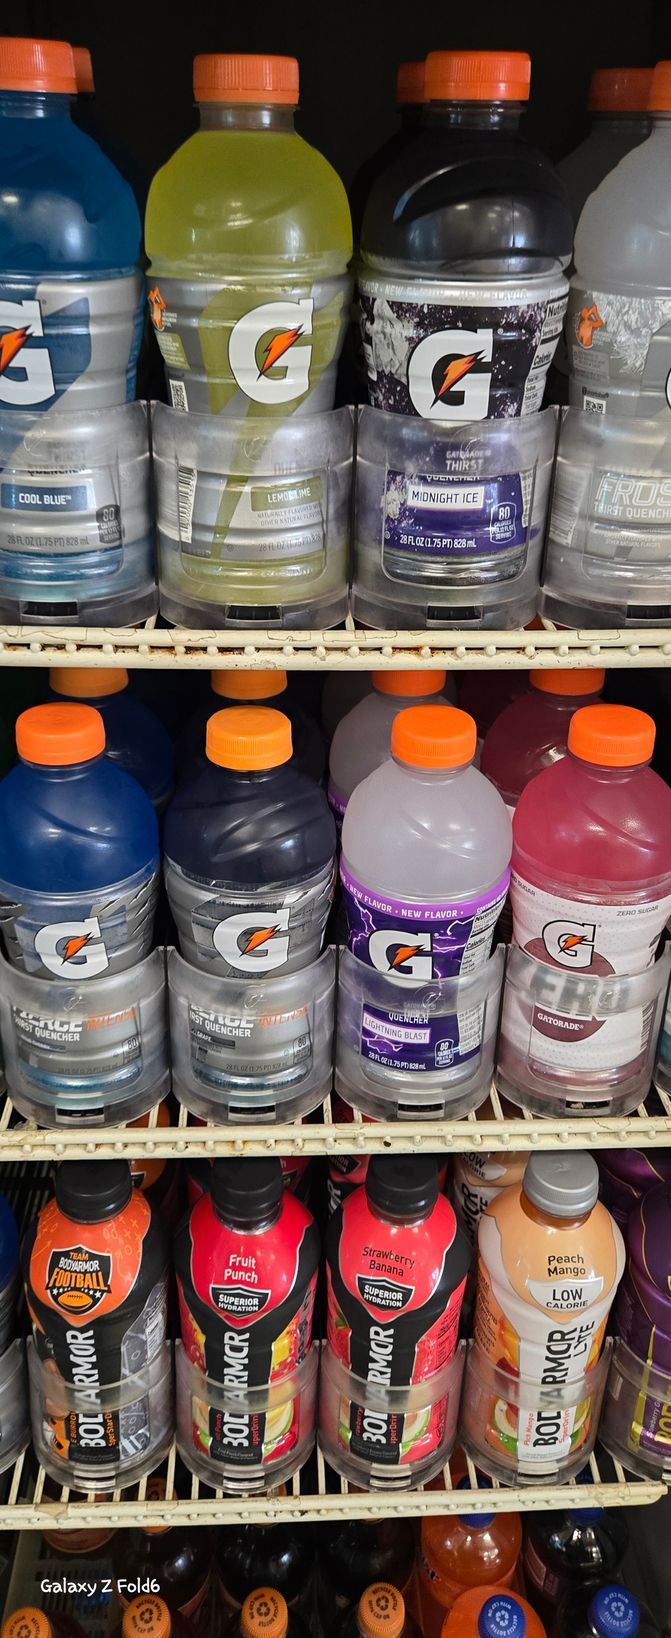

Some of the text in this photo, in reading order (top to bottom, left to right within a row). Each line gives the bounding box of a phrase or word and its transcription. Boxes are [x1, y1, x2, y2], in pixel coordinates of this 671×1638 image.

[446, 460, 484, 472] THIRST
[18, 493, 42, 505] COOL
[412, 491, 479, 504] MIDNIGHT ICE
[103, 507, 115, 522] 80
[498, 506, 511, 521] 80
[594, 502, 623, 516] TIRST
[25, 536, 35, 547] OZ
[400, 534, 477, 549] 28 FL OZ (1.75 PT) 828 mL
[350, 886, 458, 919] NEW FLAVOR NEW FLAVOR
[638, 904, 659, 915] SUGAR
[35, 1028, 81, 1042] QUENCHER
[204, 1021, 251, 1038] QUENCHER
[364, 1017, 427, 1041] LIGHTNING BLAST
[128, 1037, 138, 1050] 80
[298, 1037, 307, 1048] 80
[440, 1042, 449, 1051] 80
[375, 1054, 381, 1062] FL
[381, 1057, 388, 1065] OZ
[409, 1062, 419, 1070] 828
[70, 1252, 89, 1260] TEAM
[229, 1254, 256, 1269] Fruit
[362, 1246, 415, 1269] Strawberry
[548, 1254, 584, 1266] Peach
[58, 1257, 100, 1272] BODYARMOR
[369, 1260, 404, 1276] Banana
[548, 1266, 586, 1277] Mango
[49, 1267, 108, 1291] FOOTBALL
[224, 1268, 259, 1284] Punch
[218, 1294, 259, 1306] SUPERIOR
[363, 1293, 403, 1307] HYDRATION
[364, 1285, 403, 1301] SUPERIOR
[552, 1288, 583, 1302] LOW
[218, 1302, 259, 1312] HYDRATION
[546, 1300, 589, 1310] CALORIE
[573, 1320, 595, 1358] LYTE
